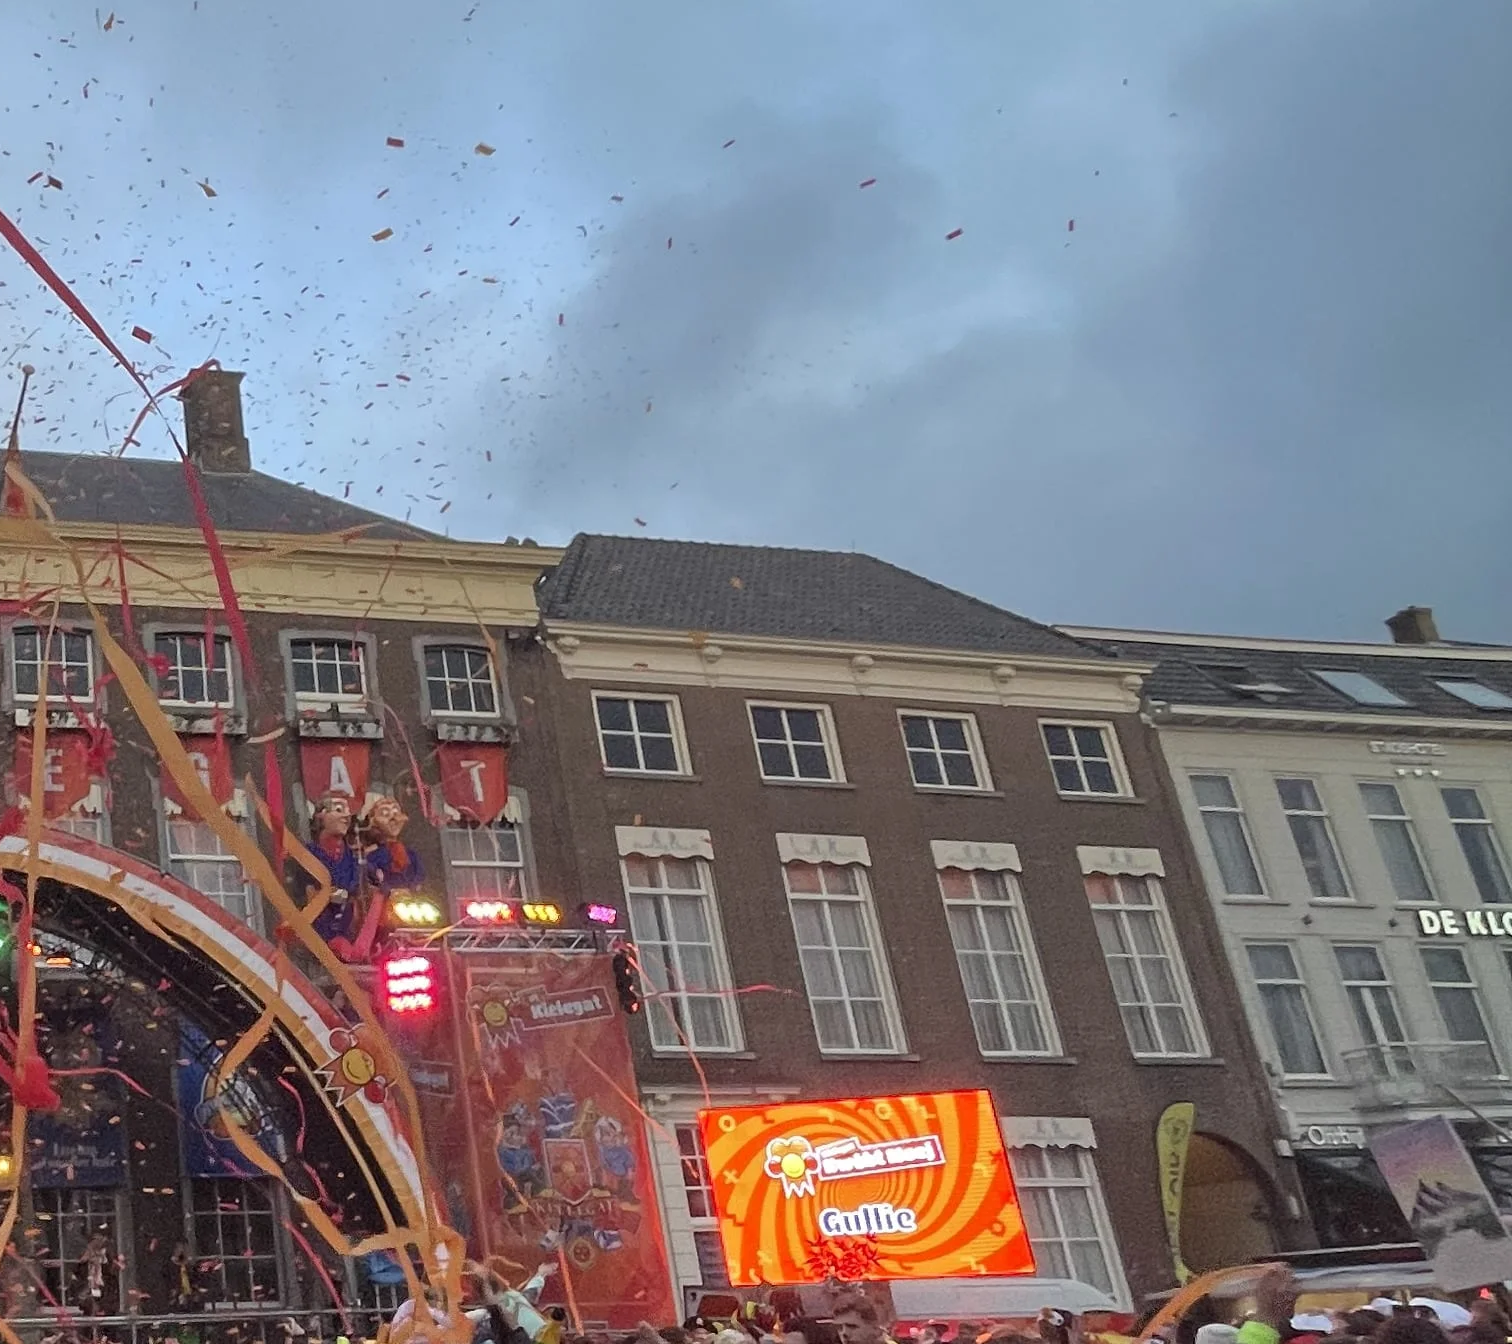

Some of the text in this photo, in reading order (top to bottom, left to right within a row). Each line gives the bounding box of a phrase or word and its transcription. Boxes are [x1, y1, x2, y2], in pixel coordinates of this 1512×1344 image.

[44, 748, 65, 792] E
[329, 755, 355, 797] A
[459, 760, 486, 803] T
[1418, 909, 1459, 935] DE
[821, 1205, 914, 1234] Gullie
